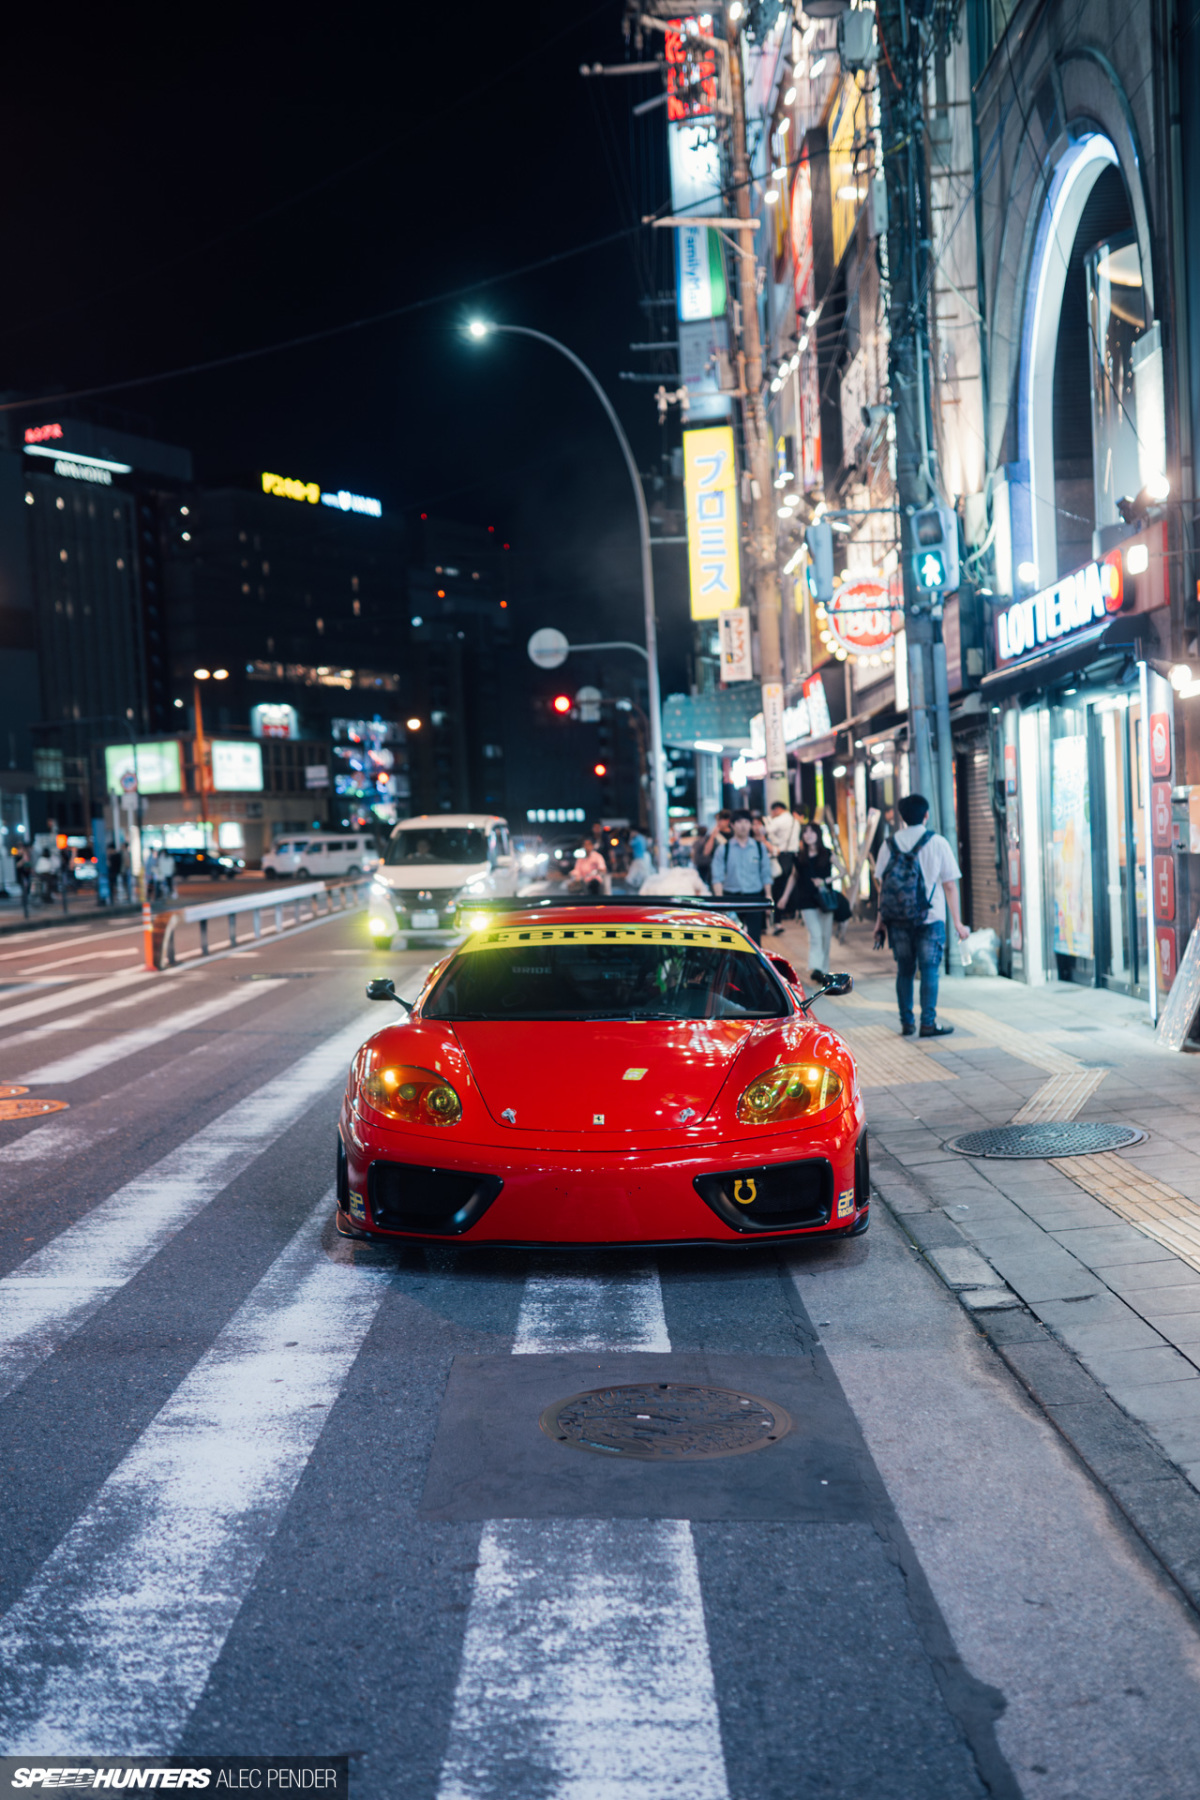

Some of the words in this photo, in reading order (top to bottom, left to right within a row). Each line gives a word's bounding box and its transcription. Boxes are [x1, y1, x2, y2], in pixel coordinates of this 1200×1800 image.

[696, 452, 729, 593] プロミス
[998, 562, 1105, 660] LOTTERIA
[480, 929, 735, 945] Ferrari
